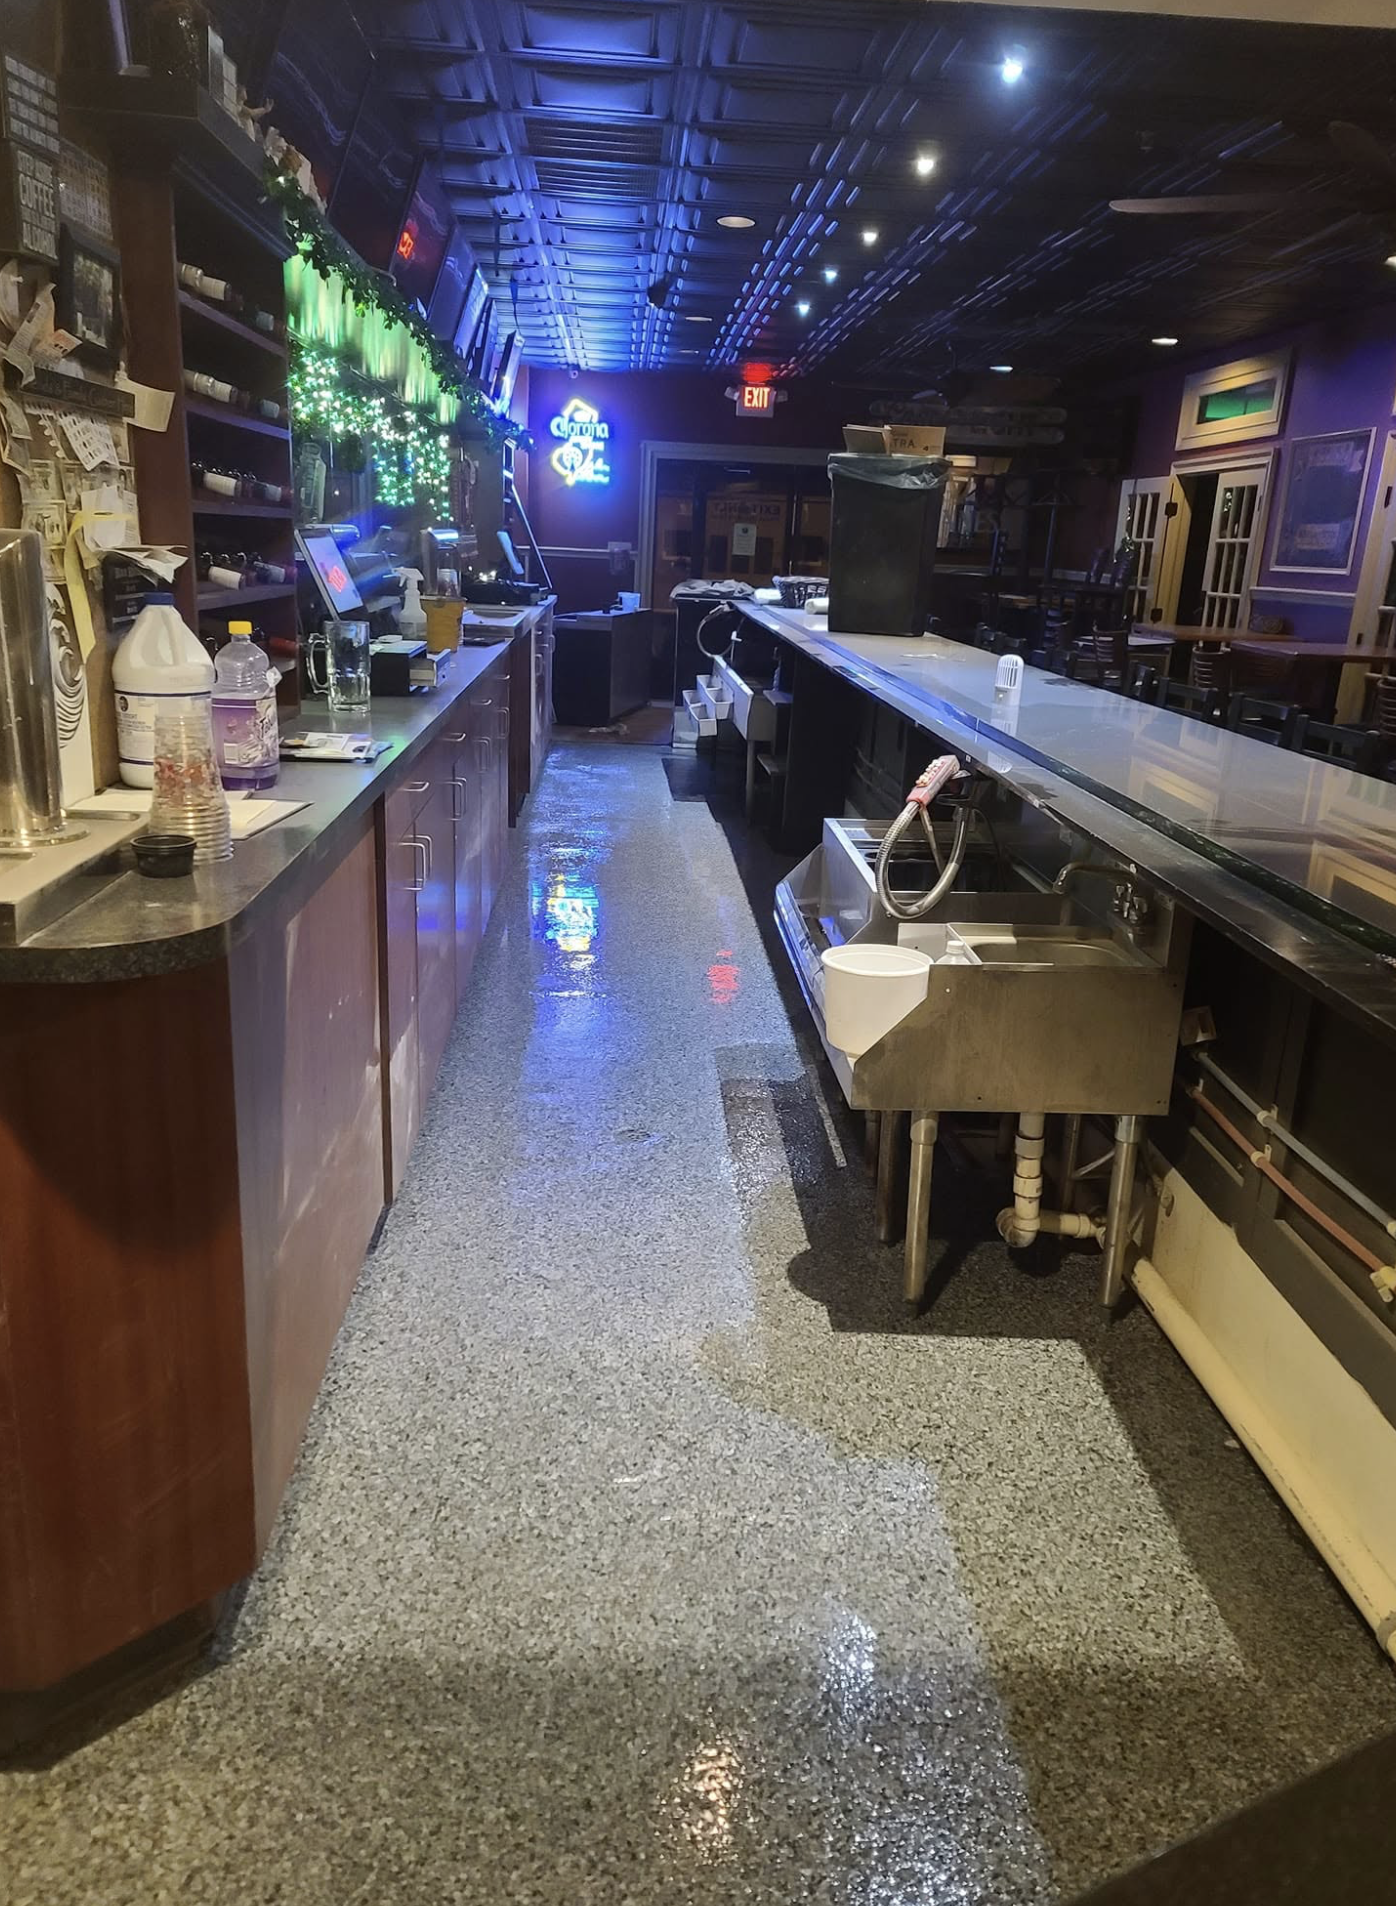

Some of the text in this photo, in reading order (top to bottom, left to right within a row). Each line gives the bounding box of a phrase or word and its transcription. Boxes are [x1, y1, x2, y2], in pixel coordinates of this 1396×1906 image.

[19, 173, 55, 218] COFFEE
[744, 386, 770, 408] EXIT
[550, 415, 609, 439] Corona
